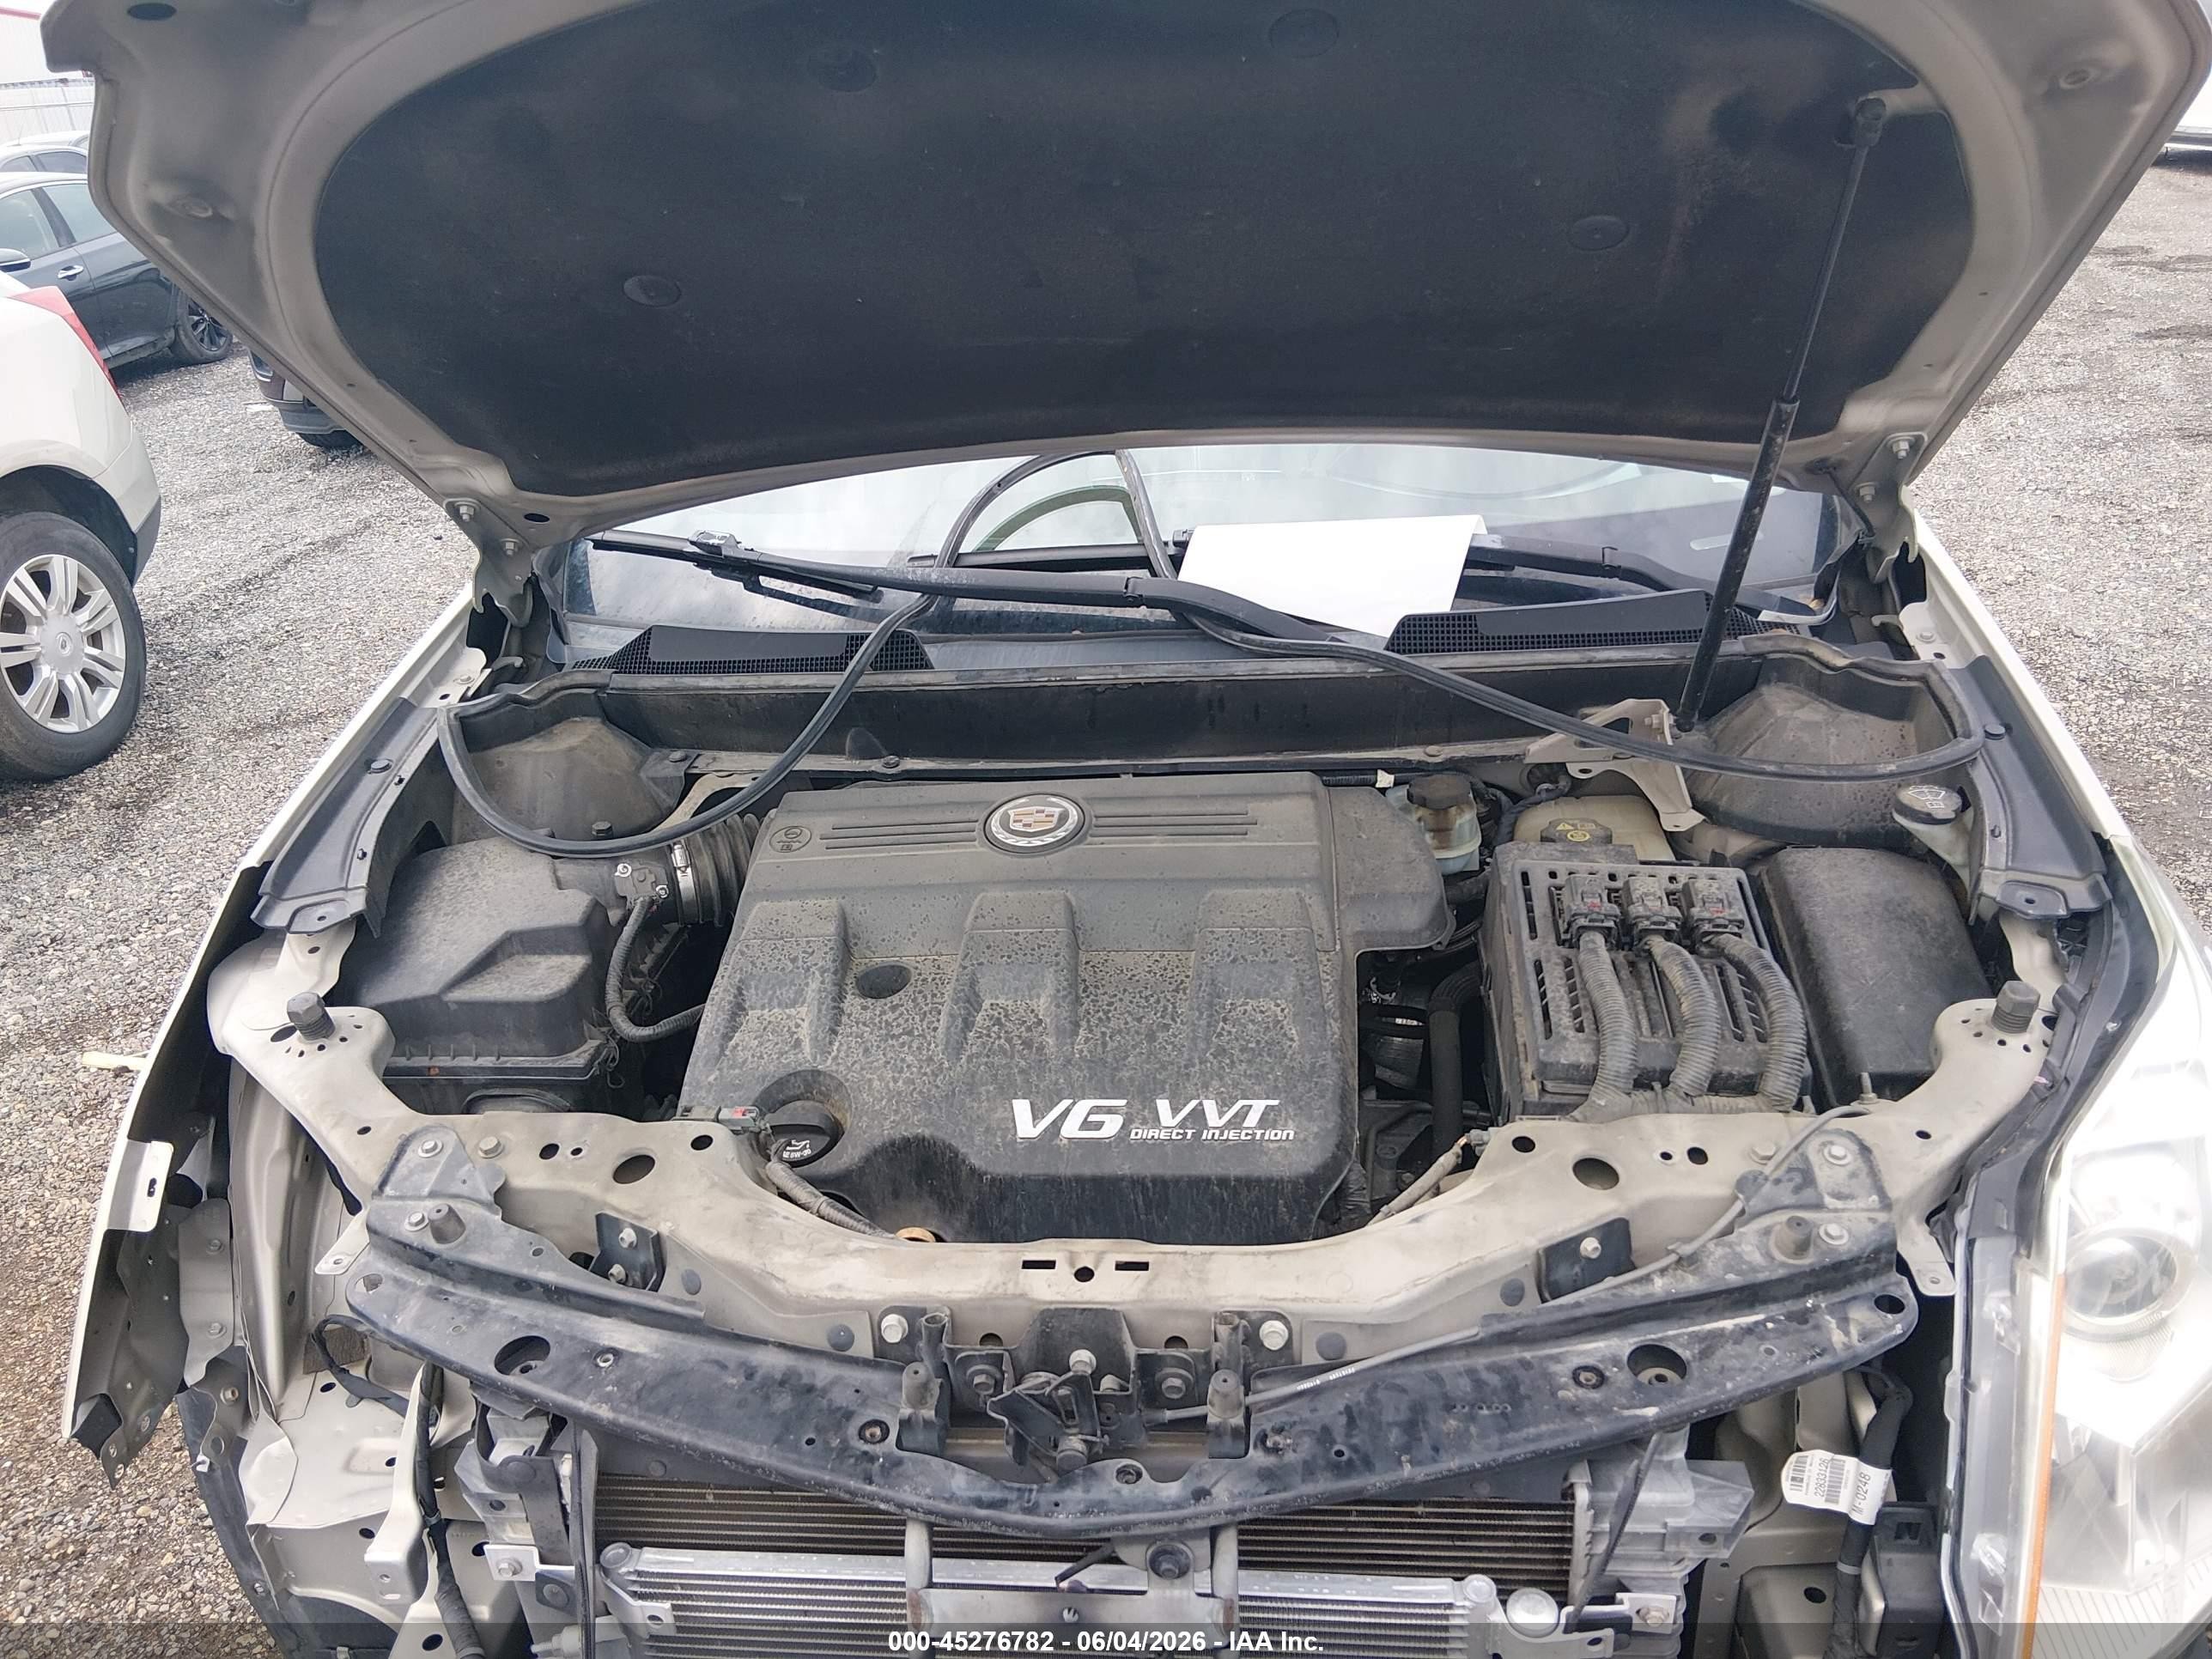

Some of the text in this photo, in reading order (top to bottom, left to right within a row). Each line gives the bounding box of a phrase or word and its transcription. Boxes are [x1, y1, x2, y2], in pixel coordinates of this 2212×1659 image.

[1012, 1098, 1279, 1139] V6 VVT
[1129, 1128, 1294, 1141] DIRECT INJECTION
